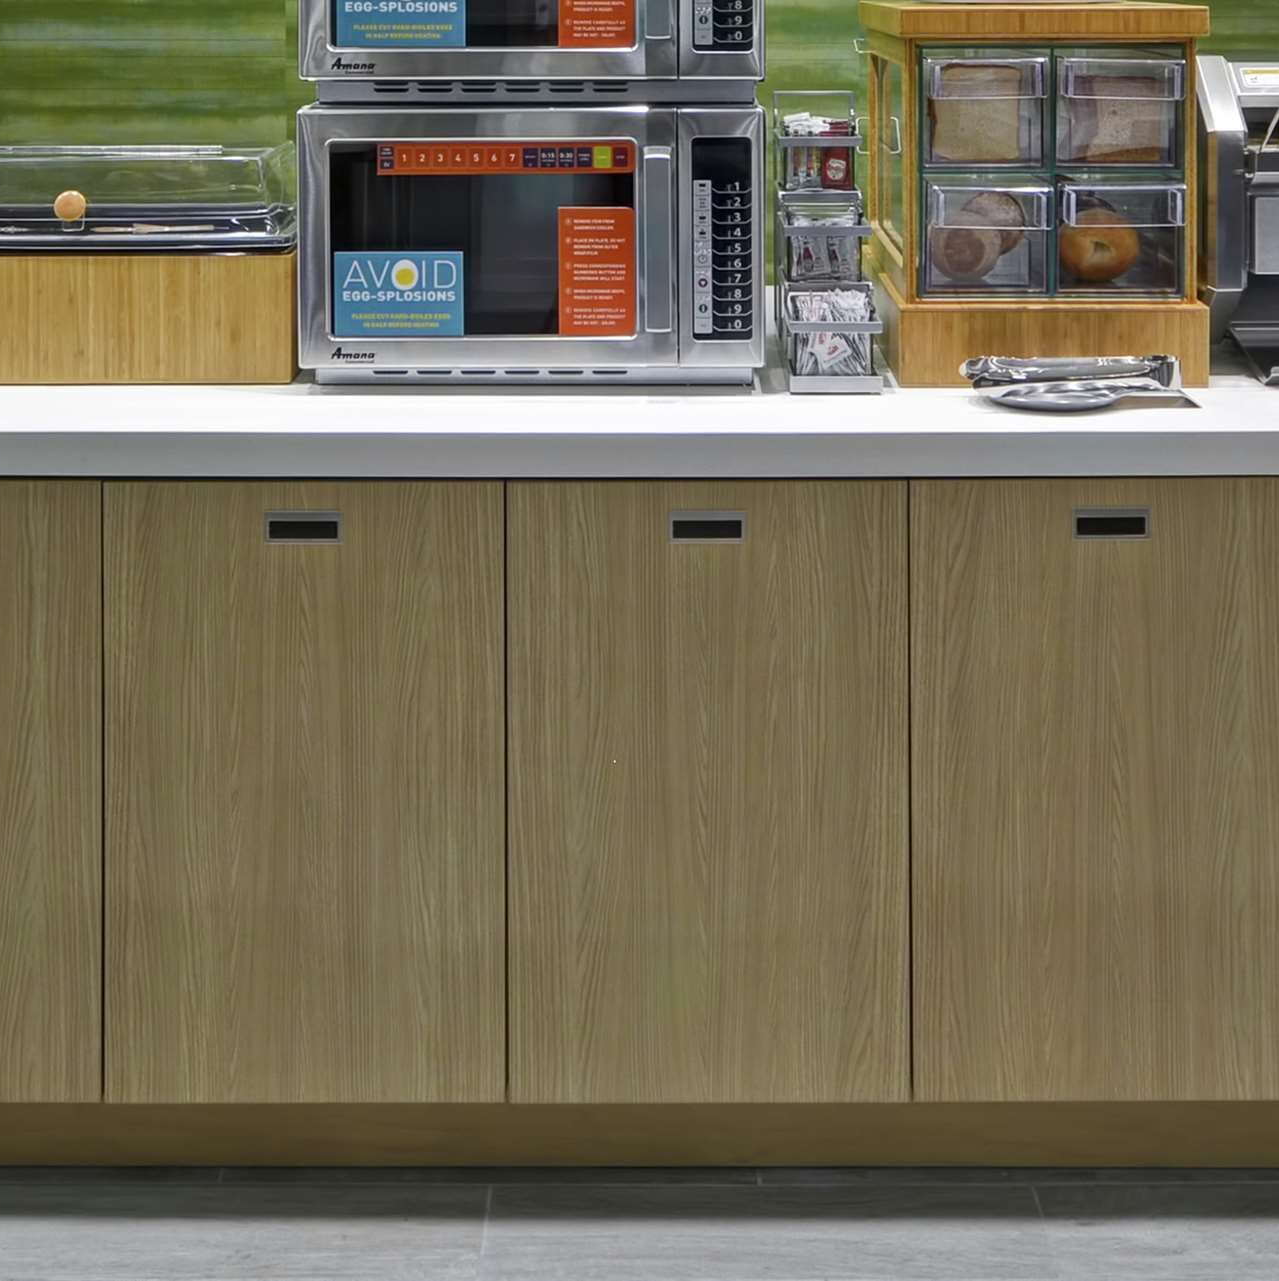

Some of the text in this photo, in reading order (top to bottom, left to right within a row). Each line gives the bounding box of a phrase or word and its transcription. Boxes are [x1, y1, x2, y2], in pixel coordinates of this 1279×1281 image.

[345, 2, 458, 12] EGG-SPLOSIONS
[331, 57, 376, 70] Amana
[343, 259, 457, 290] AVOID
[343, 291, 456, 301] EGG-SPLOSIONS
[331, 346, 376, 360] Amana
